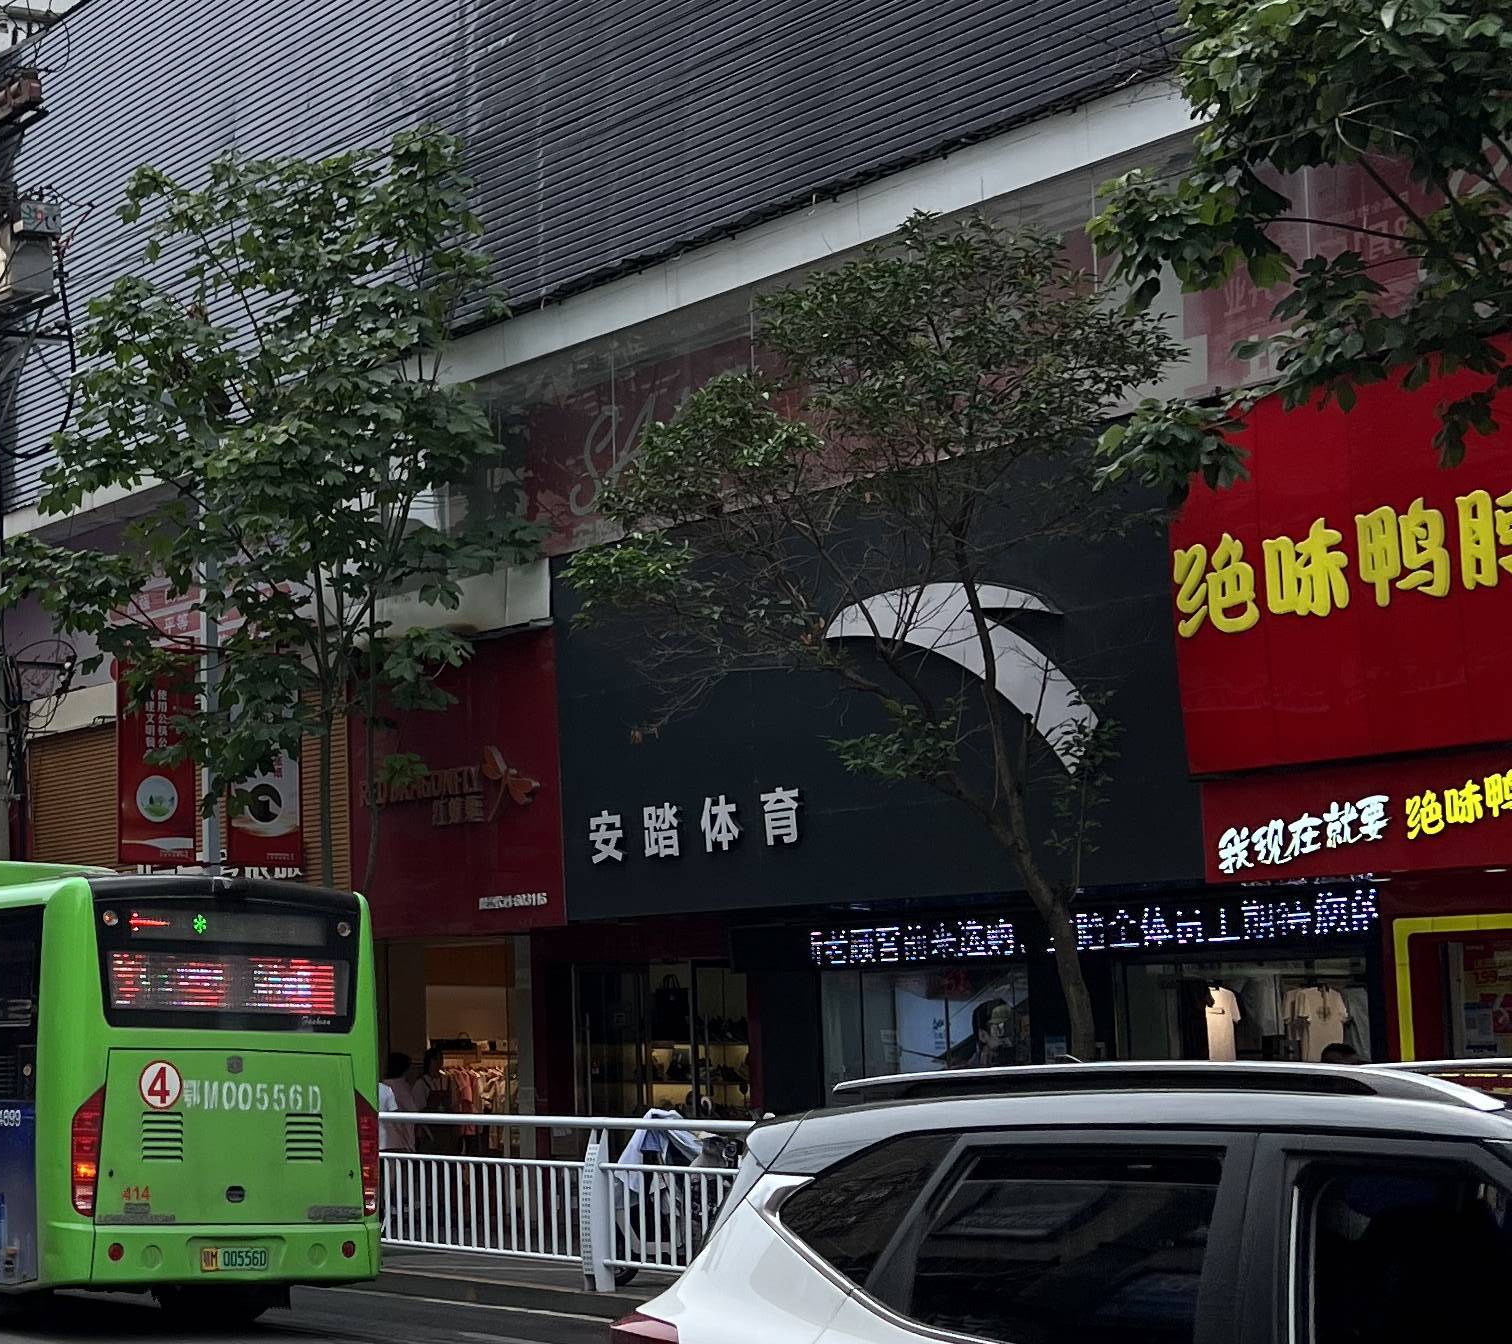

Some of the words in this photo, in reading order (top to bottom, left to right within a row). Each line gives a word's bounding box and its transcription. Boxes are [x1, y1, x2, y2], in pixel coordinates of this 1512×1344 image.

[157, 689, 168, 751] 使用公筷公
[589, 787, 800, 864] 安踏体育
[1217, 795, 1391, 874] 我现在就要
[147, 1066, 171, 1105] 4
